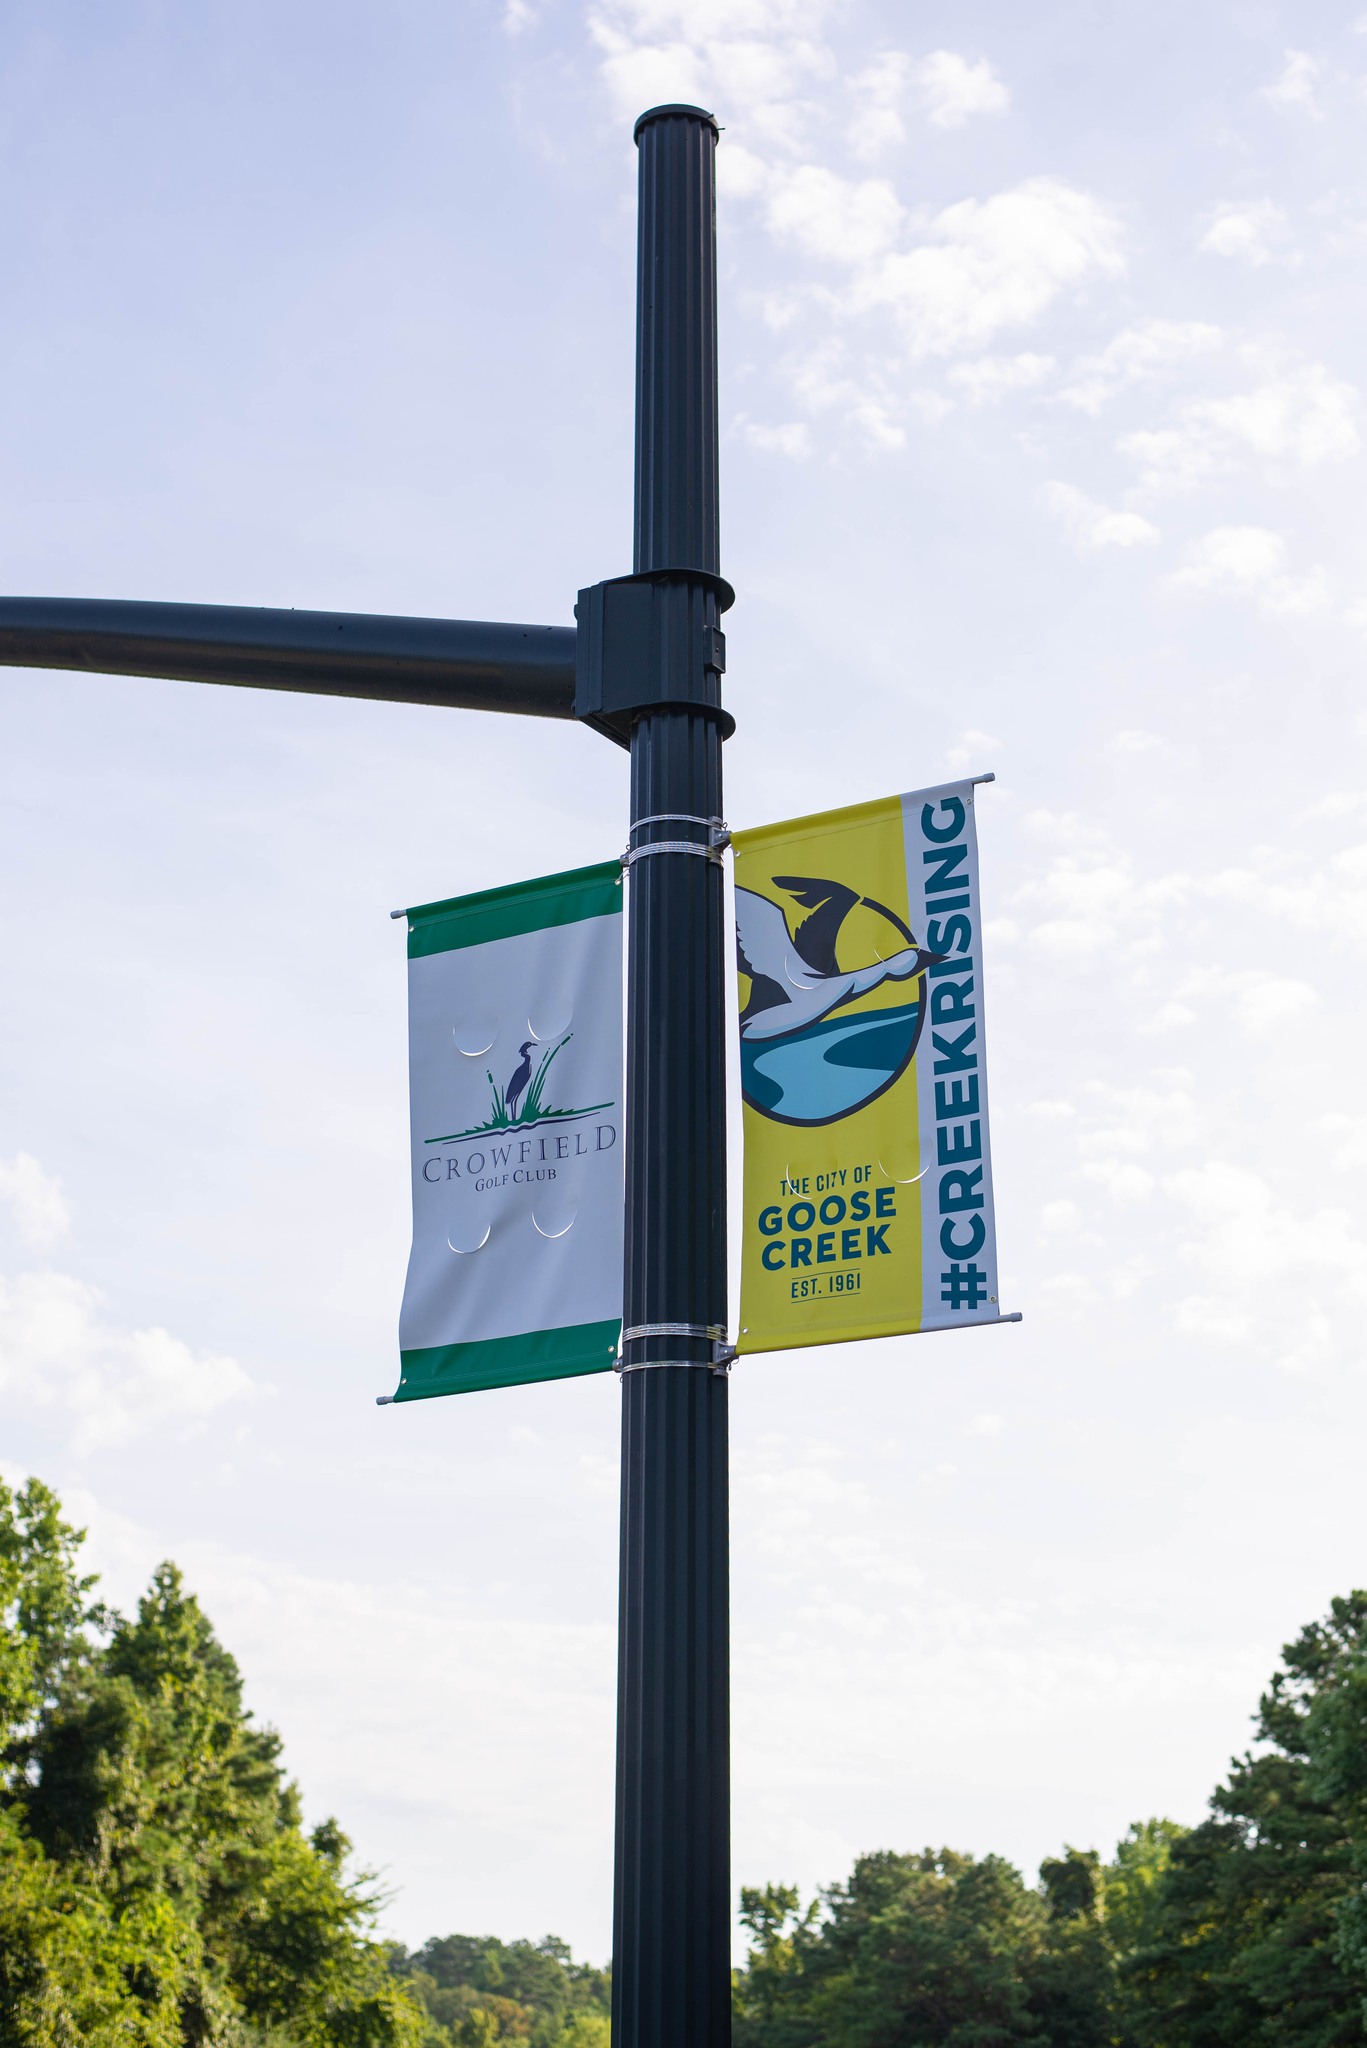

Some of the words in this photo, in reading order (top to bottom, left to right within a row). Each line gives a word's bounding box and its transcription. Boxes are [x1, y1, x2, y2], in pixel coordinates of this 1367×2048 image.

[921, 796, 987, 1309] #CREEKRISING
[422, 1125, 616, 1183] CROWFIELD
[475, 1174, 509, 1192] GOLF
[513, 1168, 557, 1184] CLUB
[780, 1177, 810, 1196] THE
[816, 1169, 847, 1192] CITY
[854, 1165, 872, 1183] OF
[758, 1186, 897, 1236] GOOSE
[761, 1223, 892, 1271] CREEK
[791, 1278, 822, 1298] EST.
[829, 1273, 861, 1293] 1961
